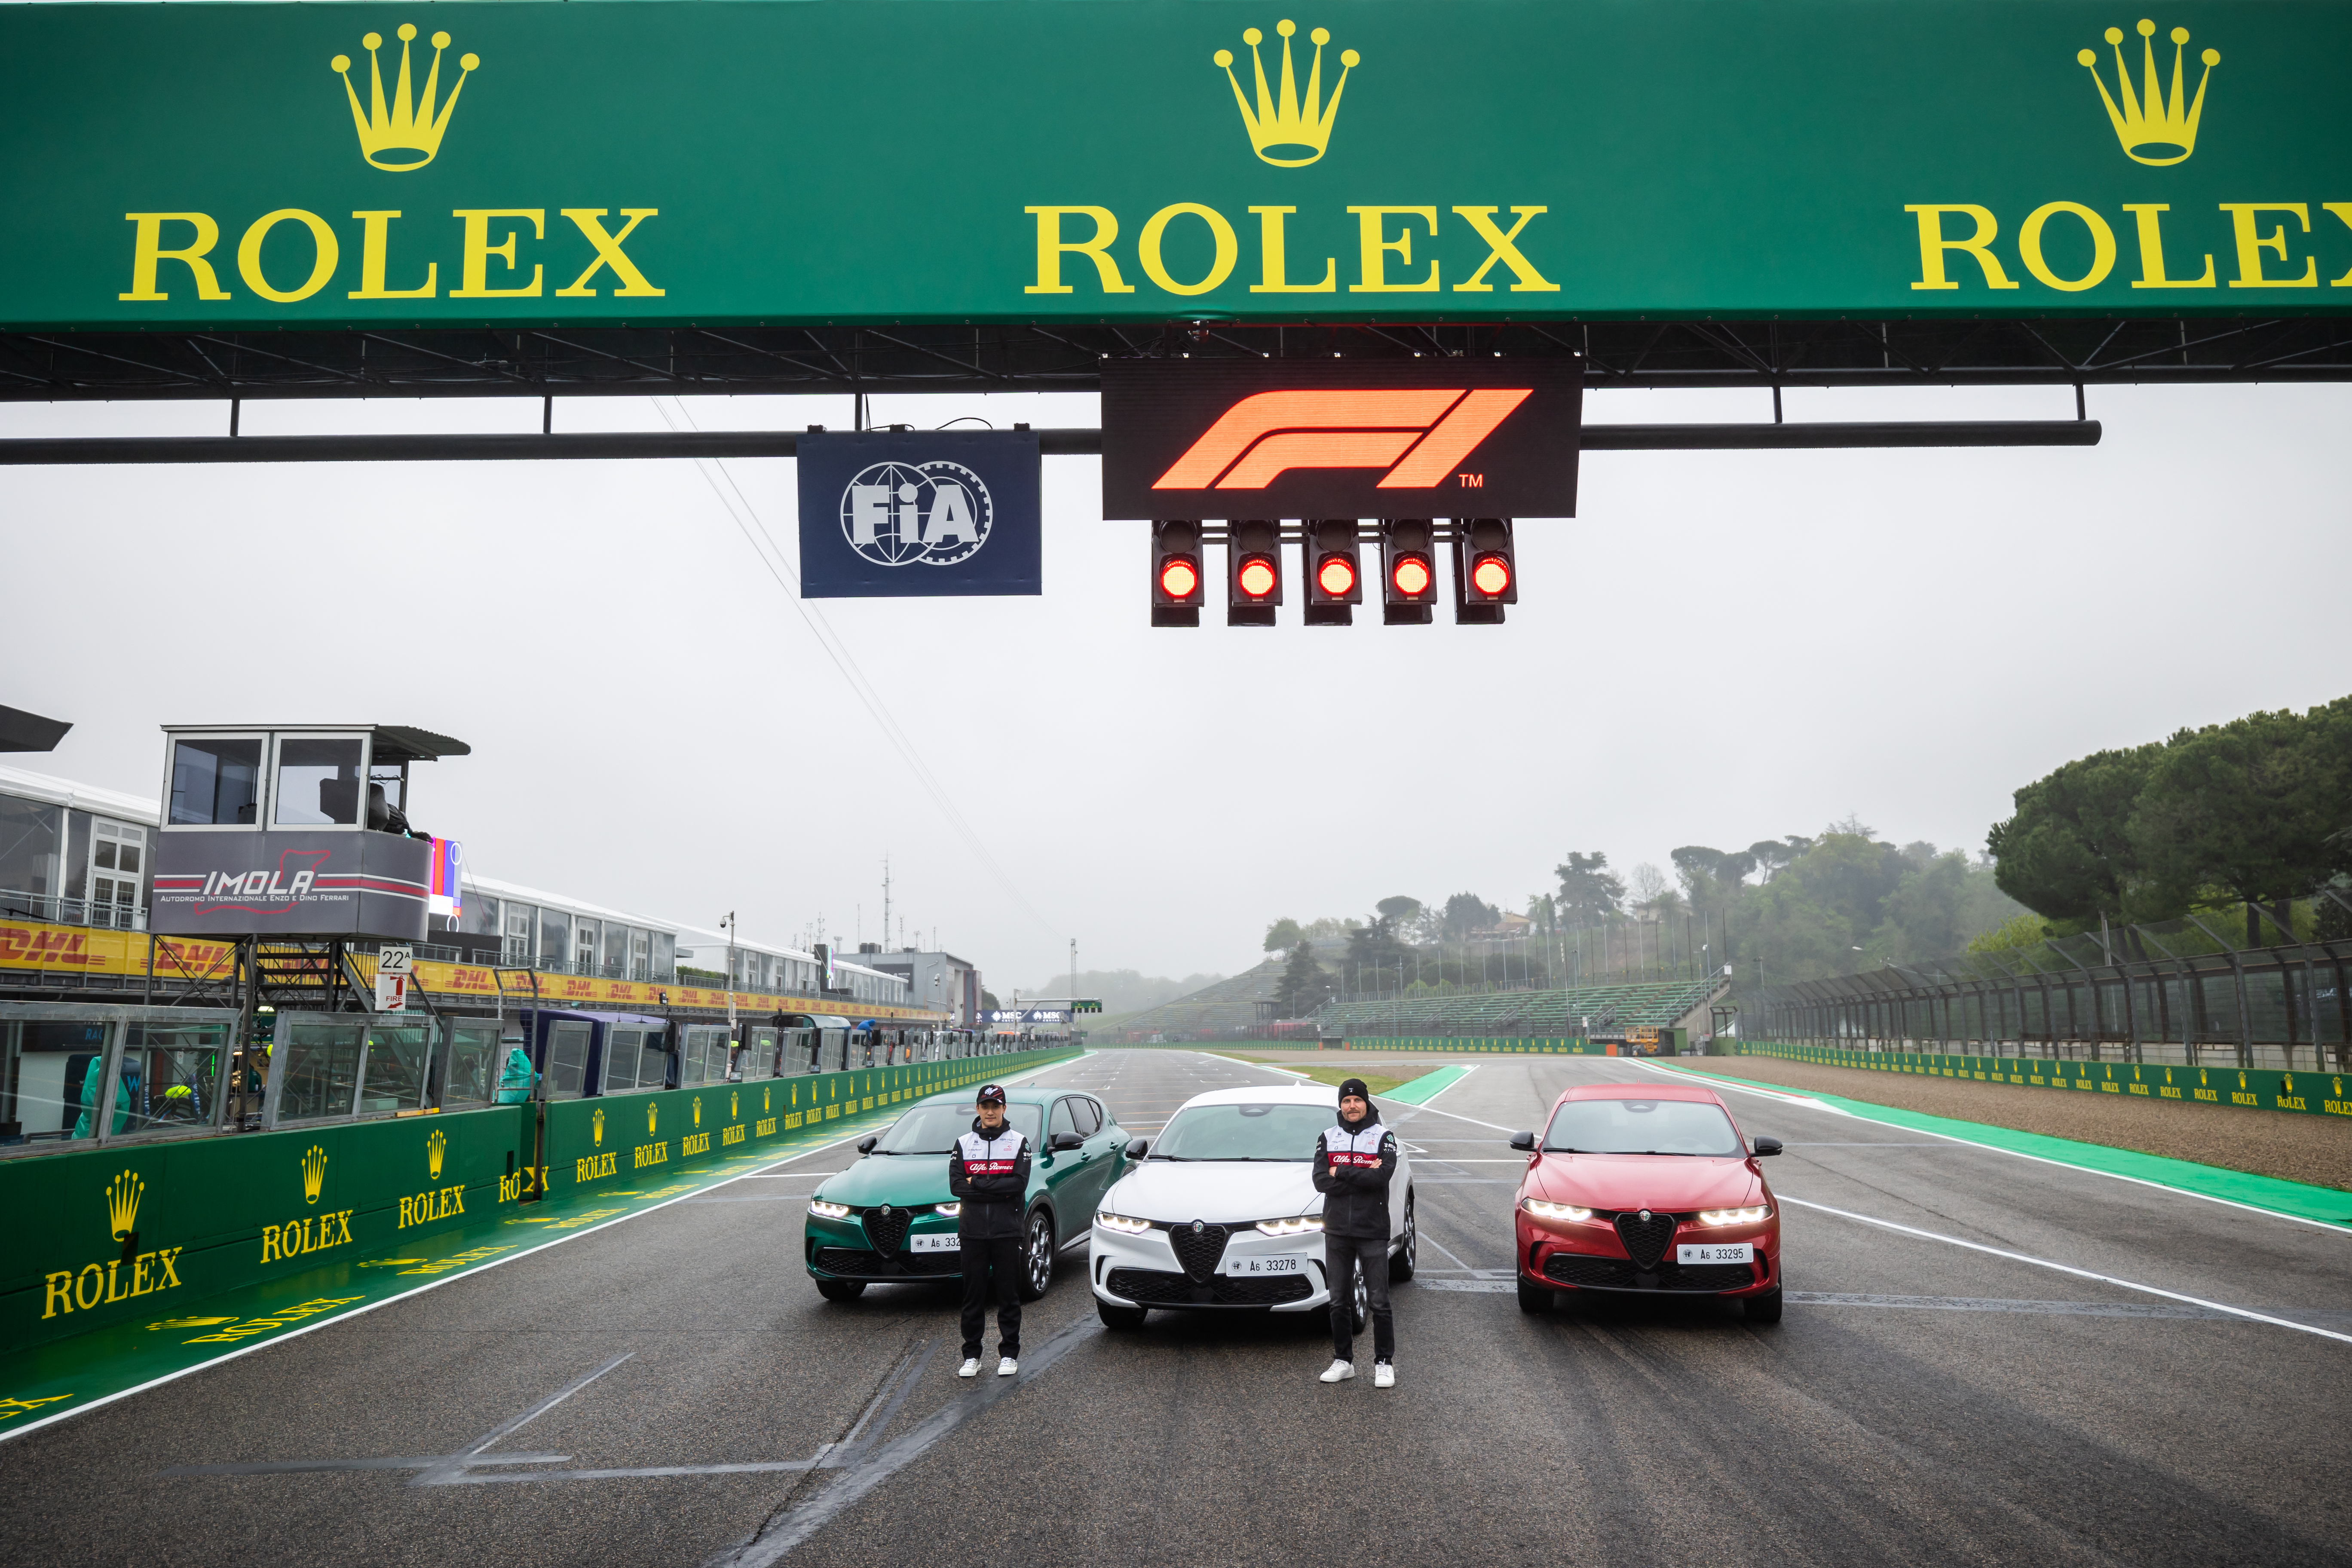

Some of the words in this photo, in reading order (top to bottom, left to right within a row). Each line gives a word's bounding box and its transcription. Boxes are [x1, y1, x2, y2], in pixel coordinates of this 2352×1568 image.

[119, 208, 665, 303] ROLEX
[1025, 202, 1560, 295] ROLEX
[1459, 474, 1483, 487] TM
[203, 871, 315, 895] IMOLA
[0, 927, 89, 965] DHL
[155, 942, 230, 973] DHL
[453, 969, 489, 990] DHL
[567, 980, 592, 996] DHL
[610, 983, 632, 999] DHL
[2052, 1077, 2067, 1087] ROLEX
[2076, 1079, 2092, 1090] ROLEX
[2101, 1081, 2119, 1093] ROLEX
[2129, 1083, 2149, 1095] ROLEX
[2160, 1086, 2182, 1098] ROLEX
[2194, 1088, 2218, 1101] ROLEX
[2232, 1092, 2258, 1106] ROLEX
[2277, 1095, 2306, 1110] ROLEX
[756, 1117, 776, 1137] ROLEX
[784, 1112, 802, 1130] ROLEX
[683, 1132, 710, 1157] ROLEX
[723, 1124, 745, 1146] ROLEX
[634, 1141, 668, 1169] ROLEX
[1333, 1155, 1351, 1165] Alfa
[576, 1152, 617, 1183] ROLEX
[970, 1163, 987, 1173] Alfa
[398, 1185, 466, 1229] ROLEX
[542, 1208, 629, 1229] ROLEX
[260, 1209, 353, 1264] ROLEX
[397, 1244, 518, 1275] ROLEX
[1716, 1248, 1743, 1259] 33295
[1266, 1259, 1296, 1271] 33278
[42, 1246, 182, 1319] ROLEX
[181, 1295, 365, 1344] ROLEX
